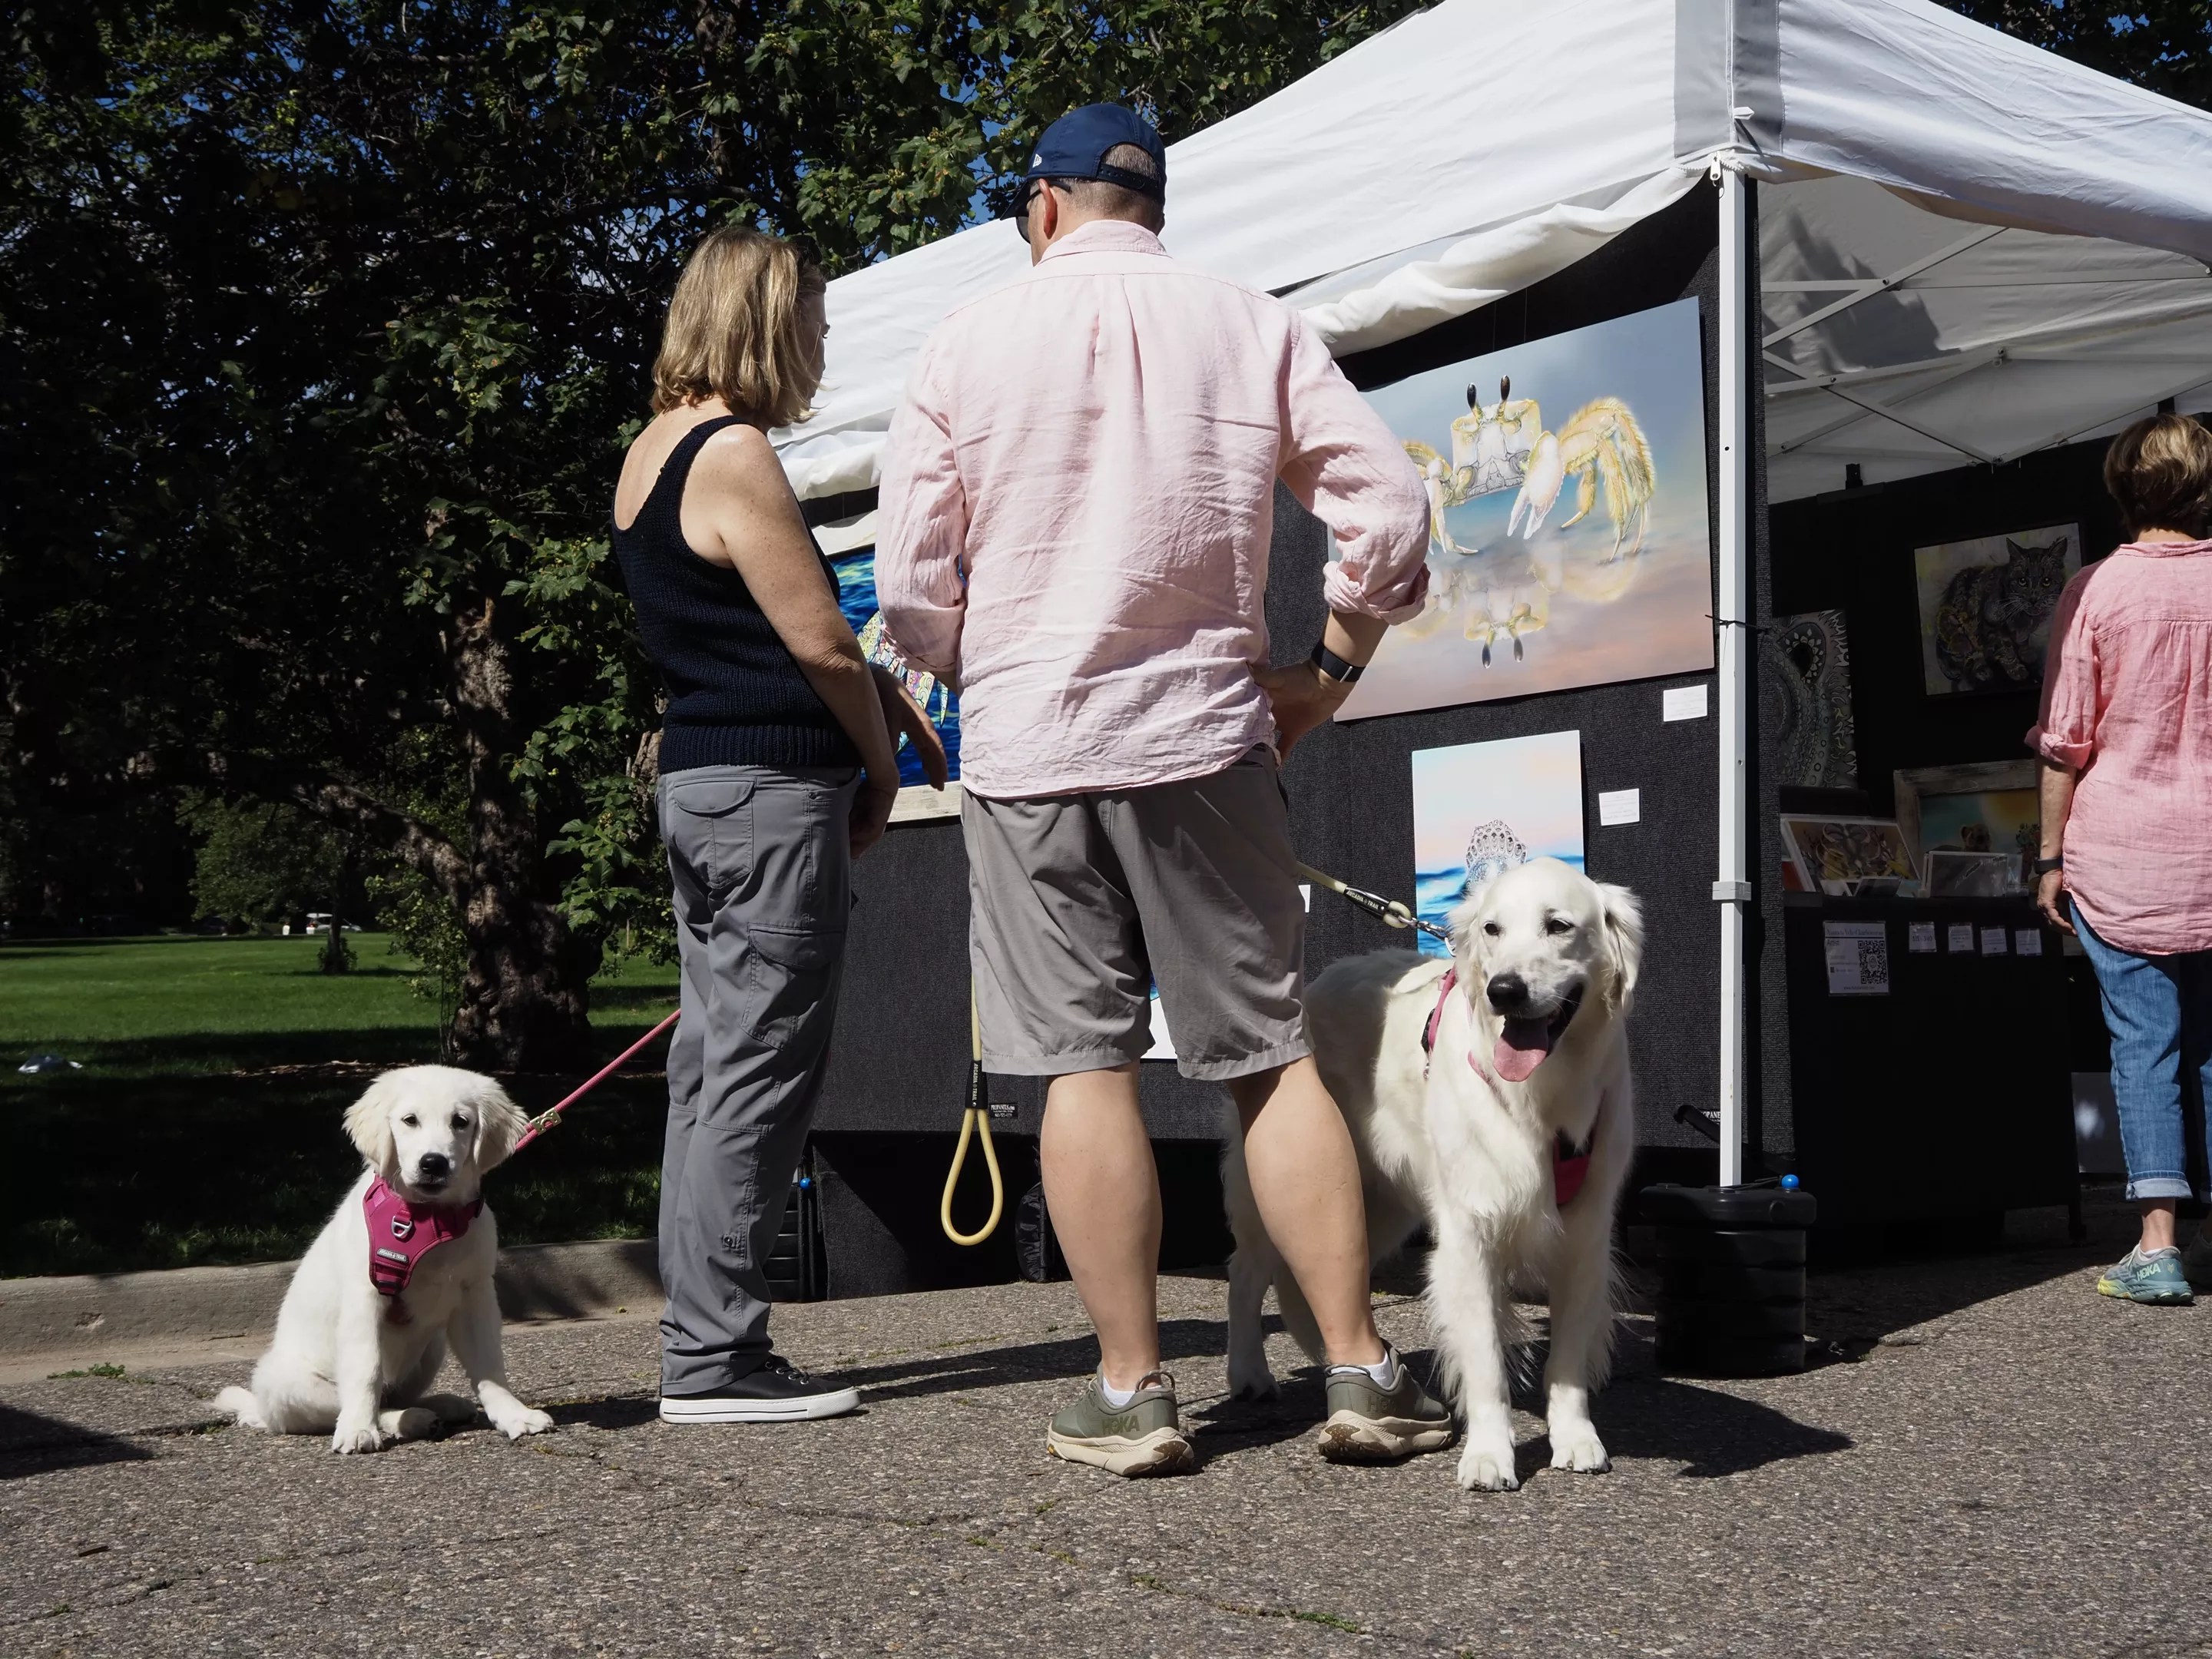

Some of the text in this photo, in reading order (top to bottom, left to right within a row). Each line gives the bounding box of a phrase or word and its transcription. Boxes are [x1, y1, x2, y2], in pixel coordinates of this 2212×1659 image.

[1346, 890, 1379, 909] ARCADIA TRAIL
[2137, 1263, 2161, 1282] HOKA
[1101, 1415, 1141, 1435] HOKA
